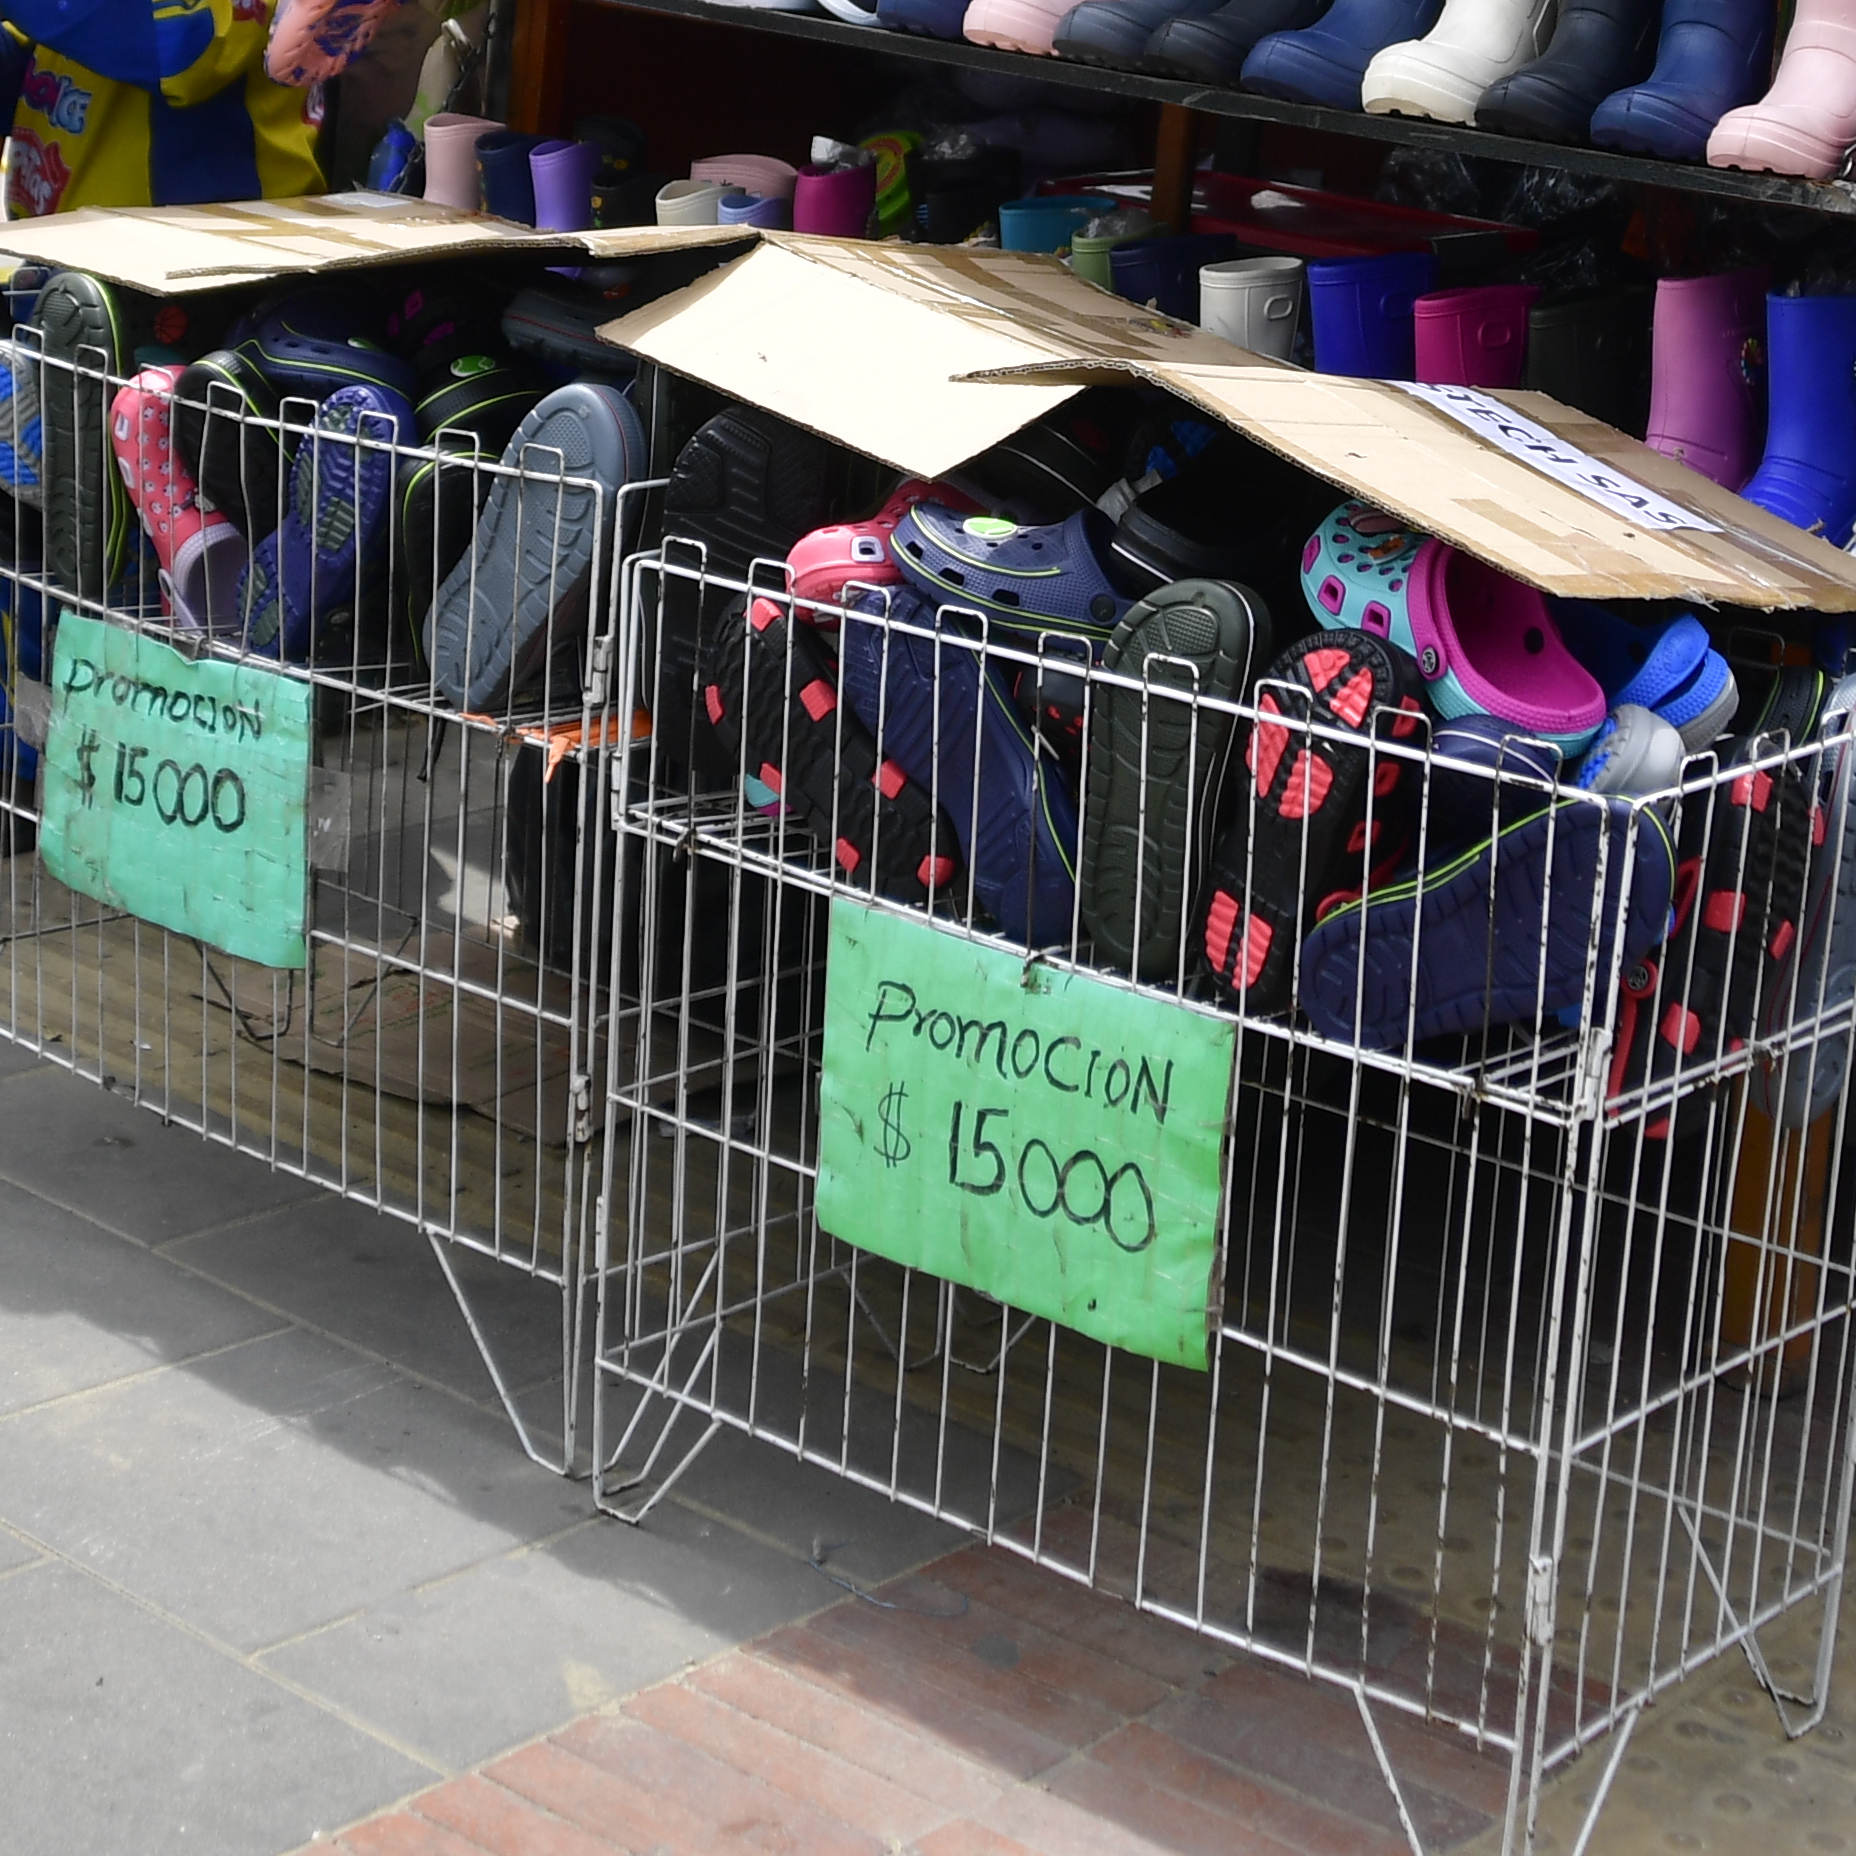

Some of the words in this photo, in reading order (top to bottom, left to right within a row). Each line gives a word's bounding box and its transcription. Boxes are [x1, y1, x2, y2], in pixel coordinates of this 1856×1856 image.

[1575, 472, 1689, 526] SAS
[74, 726, 100, 810] $
[111, 738, 246, 833] 15000
[873, 1081, 911, 1169] $
[946, 1099, 1157, 1254] 15000
